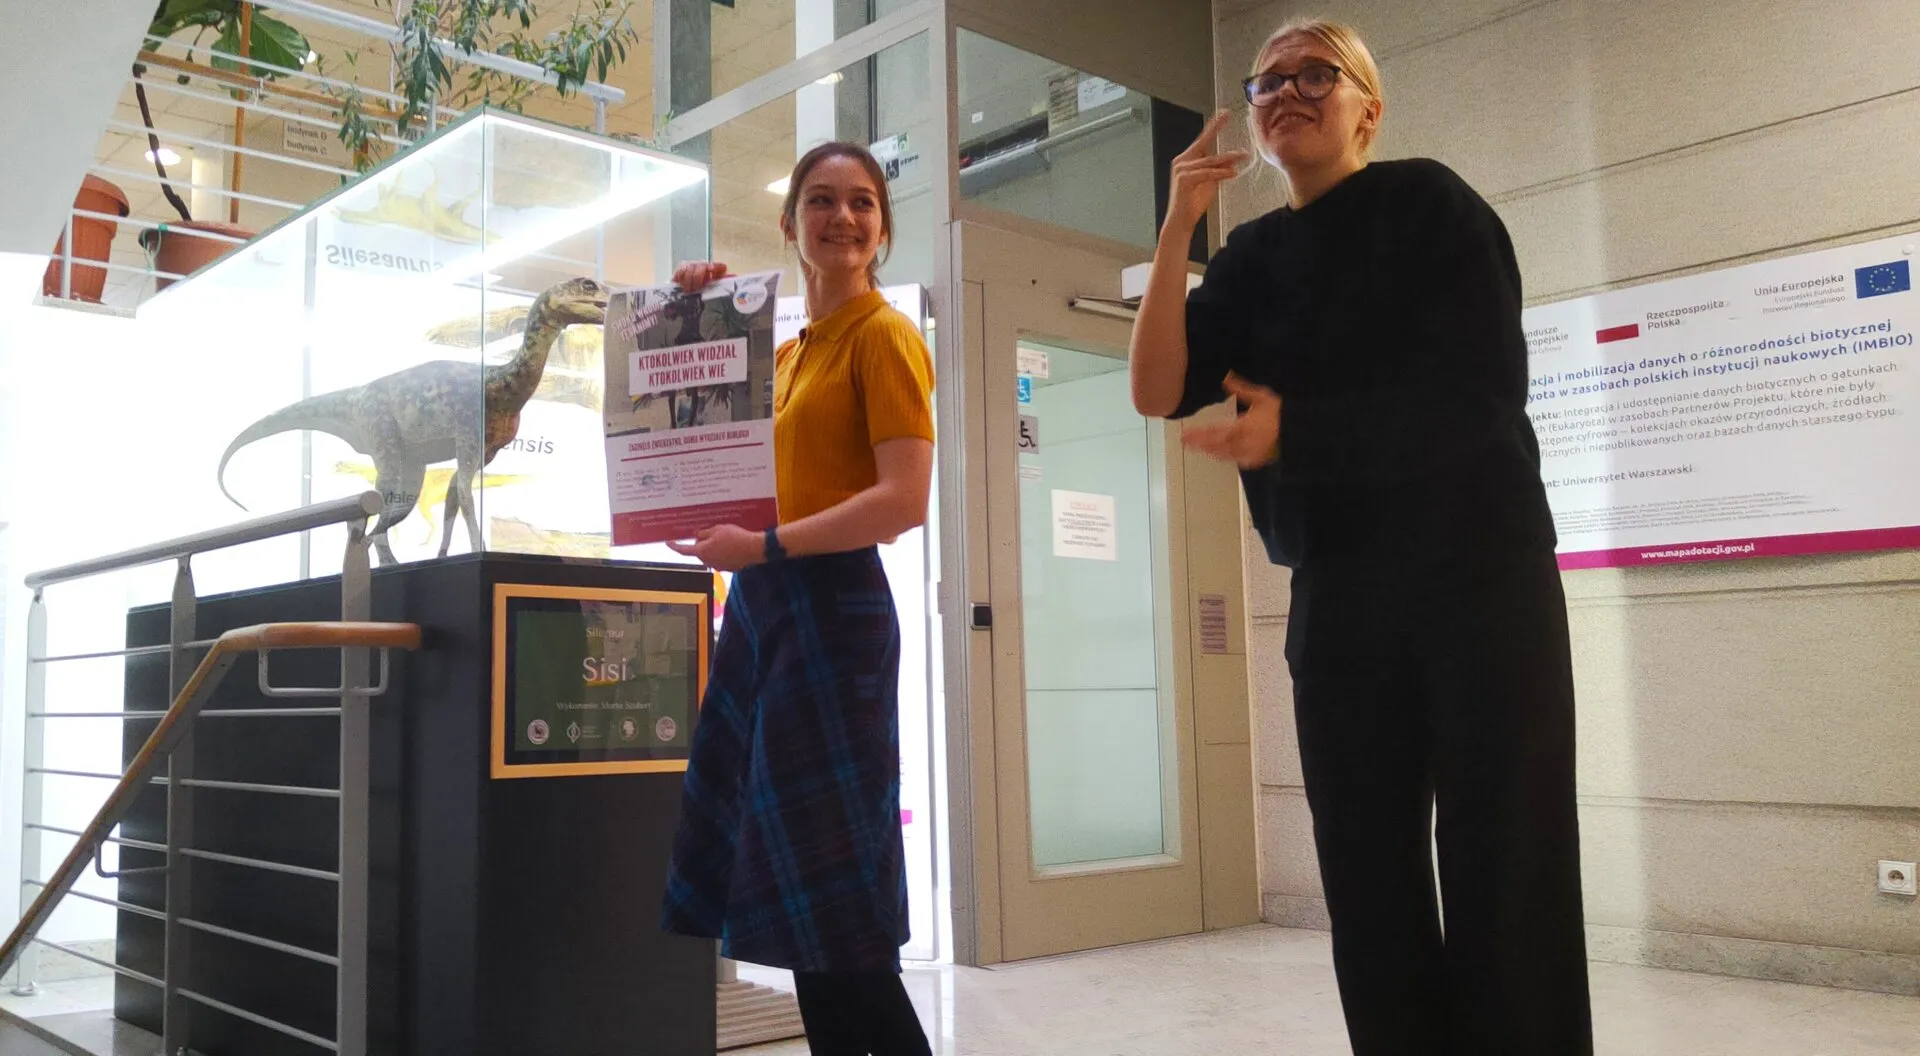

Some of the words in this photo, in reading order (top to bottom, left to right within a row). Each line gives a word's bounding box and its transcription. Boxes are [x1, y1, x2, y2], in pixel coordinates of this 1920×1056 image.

[1753, 285, 1779, 296] Unia
[1781, 274, 1844, 292] Europejska
[1646, 299, 1724, 320] Rzeczpospolita
[1647, 318, 1681, 330] Polska
[638, 350, 695, 371] KTOKOLWIEK
[698, 343, 737, 361] WIDZIAŁ
[1530, 374, 1554, 386] acja
[1557, 372, 1561, 382] i
[1565, 361, 1635, 381] mobilizacja
[1639, 352, 1686, 369] danych
[1690, 352, 1698, 361] o
[1702, 333, 1806, 359] różnorodności
[1810, 319, 1891, 343] biotycznej
[648, 367, 705, 387] KTOKOLWIEK
[708, 363, 726, 379] WIE
[1528, 391, 1556, 404] yota
[1559, 388, 1569, 397] w
[1572, 376, 1629, 395] zasobach
[1633, 367, 1689, 388] polskich
[1693, 356, 1759, 377] instytucji
[1764, 343, 1847, 366] naukowych
[1853, 333, 1913, 355] (IMBIO)
[1530, 411, 1562, 424] jektu:
[1563, 403, 1614, 417] Integracja
[1622, 390, 1700, 409] udostępnianie
[1703, 383, 1743, 398] danych
[1746, 371, 1816, 392] biotycznych
[1820, 373, 1828, 381] o
[1831, 360, 1897, 380] gatunkach
[1548, 418, 1605, 433] (Eukaryota)
[1608, 415, 1617, 424] w
[1619, 407, 1668, 422] zasobach
[1671, 399, 1730, 416] Partnerów
[1790, 386, 1823, 399] które
[1826, 383, 1845, 395] nie
[1849, 378, 1875, 392] były
[1540, 434, 1574, 447] stępne
[1576, 429, 1617, 442] cyfrowo
[1630, 419, 1687, 434] kolekcjach
[1690, 413, 1732, 427] okazów
[1832, 393, 1887, 409] źródłach
[1541, 445, 1581, 458] ficznych
[1589, 432, 1683, 453] niepublikowanych
[1687, 430, 1711, 441] oraz
[1714, 423, 1753, 438] bazach
[1757, 417, 1799, 432] danych
[1801, 410, 1862, 427] starszego
[1546, 479, 1560, 488] nt:
[1563, 471, 1625, 487] Uniwersytet
[1628, 464, 1693, 479] Warszawski
[1641, 543, 1755, 560] www.mapadotacji.gov.pl
[582, 656, 627, 682] Sisi
